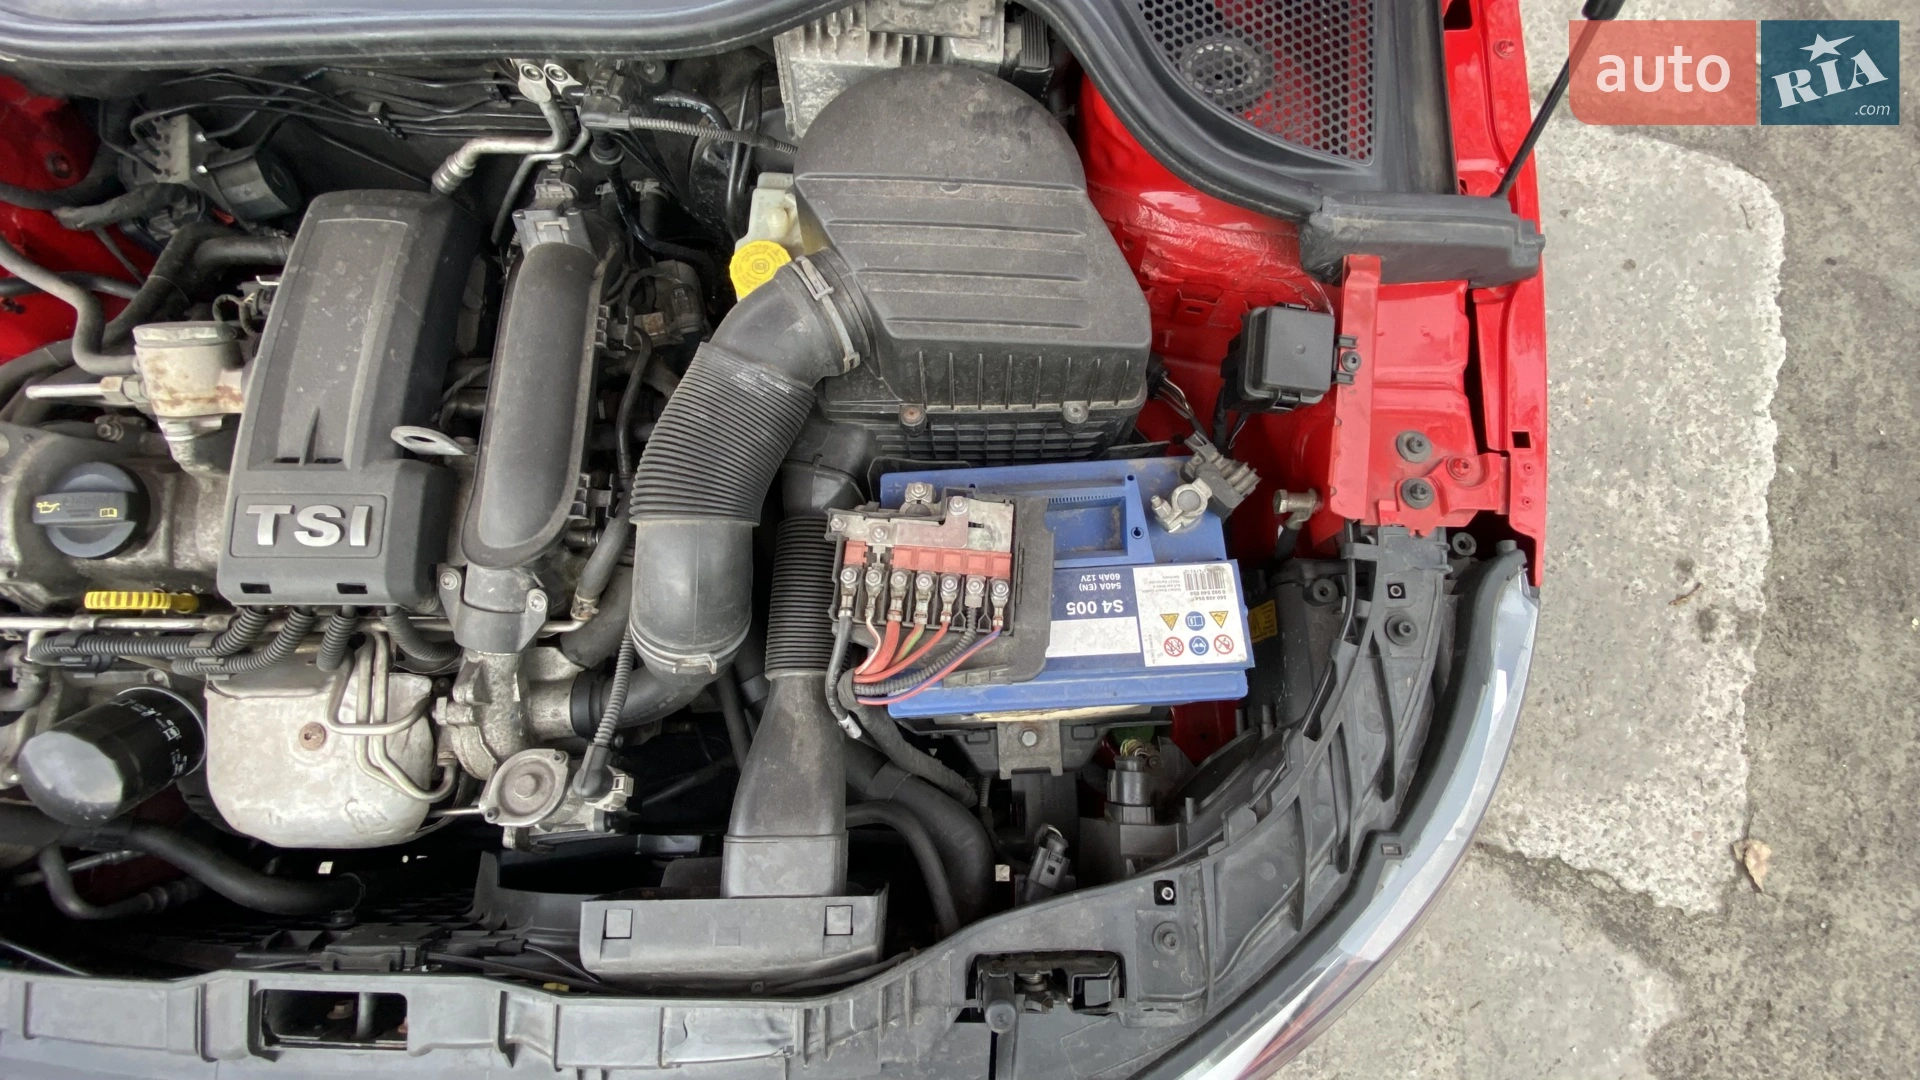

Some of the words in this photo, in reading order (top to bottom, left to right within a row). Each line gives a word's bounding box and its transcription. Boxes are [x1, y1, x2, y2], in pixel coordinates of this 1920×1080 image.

[246, 504, 373, 547] TSI
[1080, 574, 1096, 582] 12V
[1099, 573, 1120, 581] 60Ah
[1078, 582, 1097, 592] (EN)
[1099, 582, 1122, 591] 540A
[1065, 600, 1098, 615] 005
[1101, 599, 1124, 614] S4
